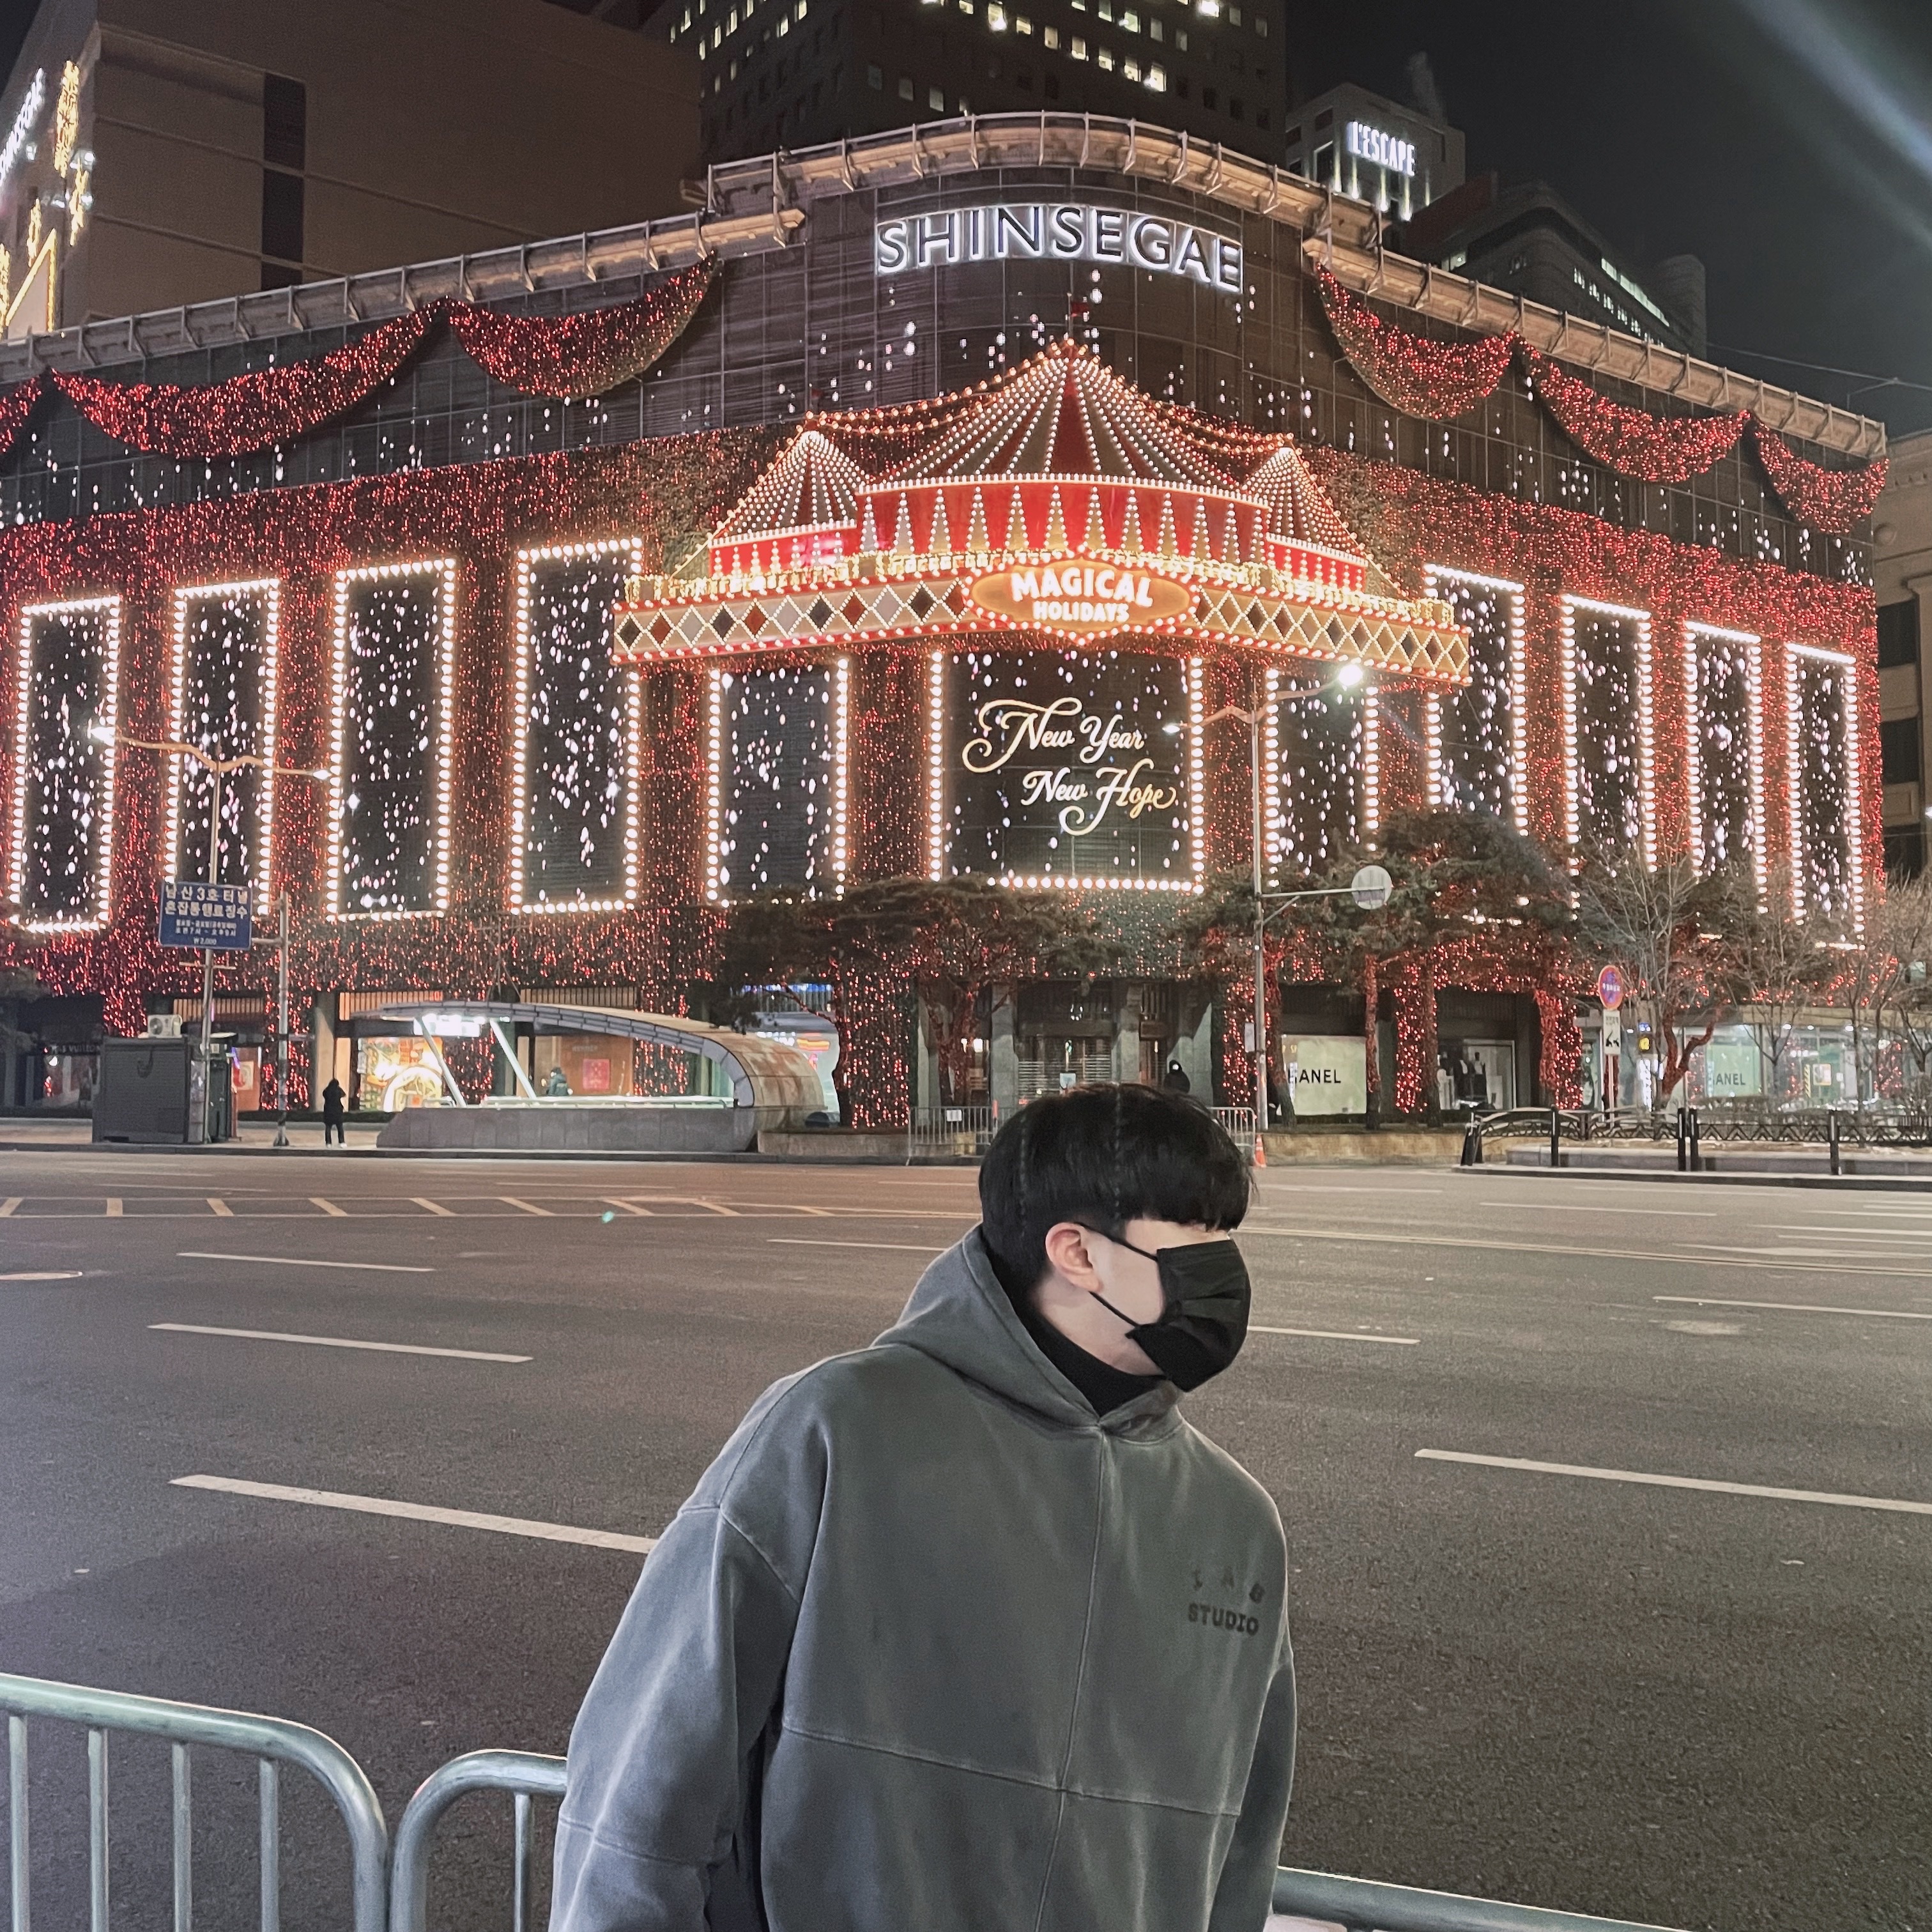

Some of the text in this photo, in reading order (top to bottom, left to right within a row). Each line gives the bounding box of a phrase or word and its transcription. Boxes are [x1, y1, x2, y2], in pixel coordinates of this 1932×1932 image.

[1348, 120, 1416, 177] L'ESCAPE
[877, 205, 1243, 293] SHINSEGAE
[1011, 567, 1154, 608] MAGICAL
[1032, 600, 1130, 623] HOLIDAYS
[962, 696, 1146, 774] New Year
[1020, 758, 1177, 837] New Hope
[1187, 1602, 1260, 1637] STUDIO
